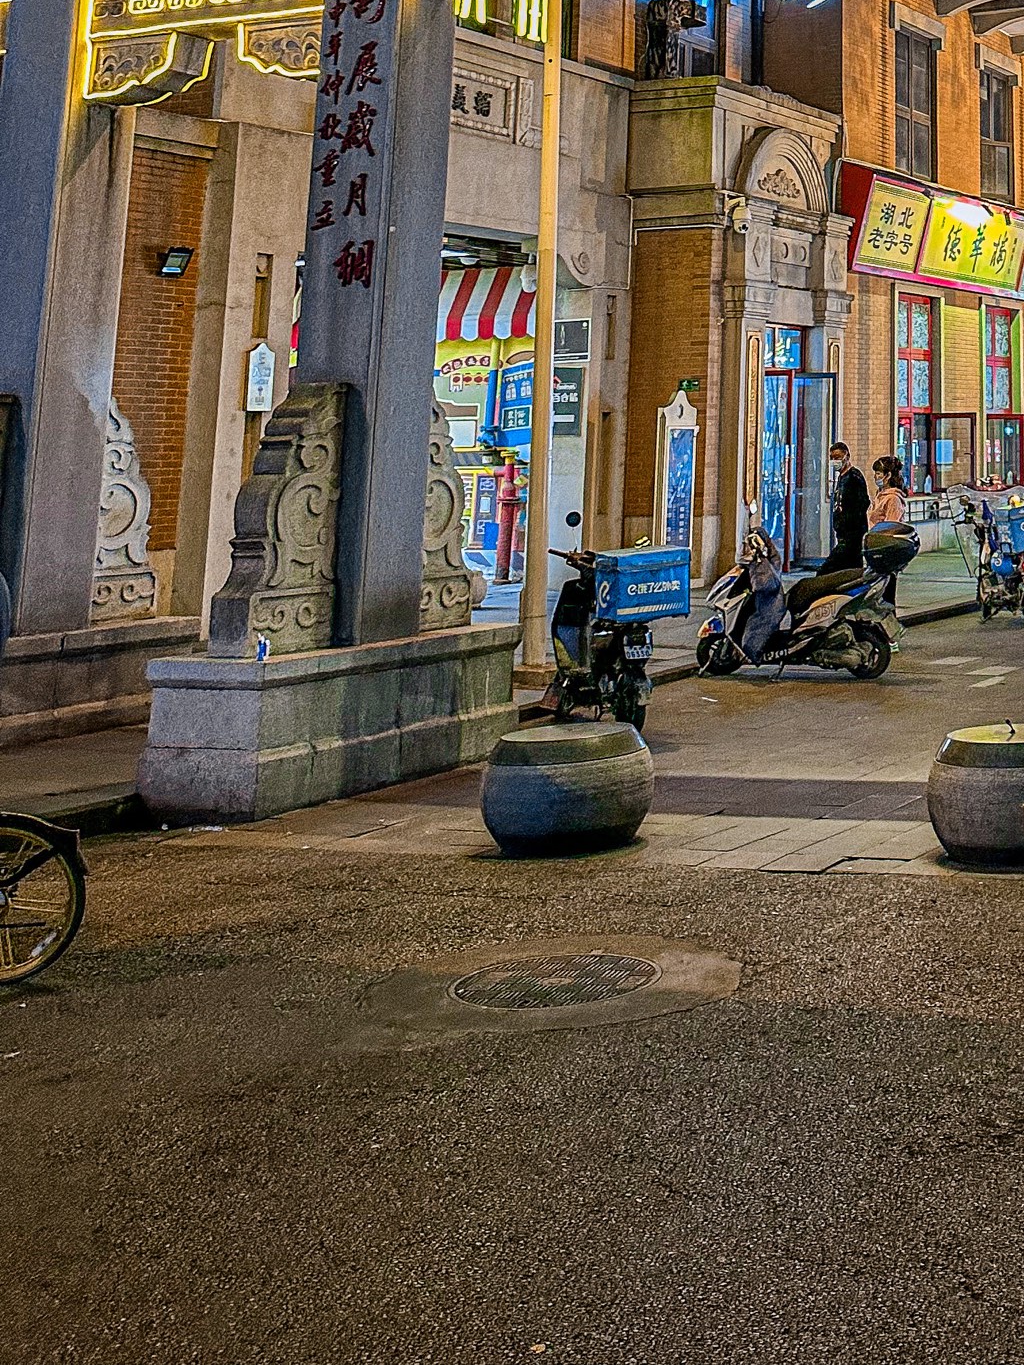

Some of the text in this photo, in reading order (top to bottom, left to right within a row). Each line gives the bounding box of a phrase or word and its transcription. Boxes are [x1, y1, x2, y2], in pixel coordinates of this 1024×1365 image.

[880, 202, 914, 229] 湖北
[868, 227, 913, 255] 老字号
